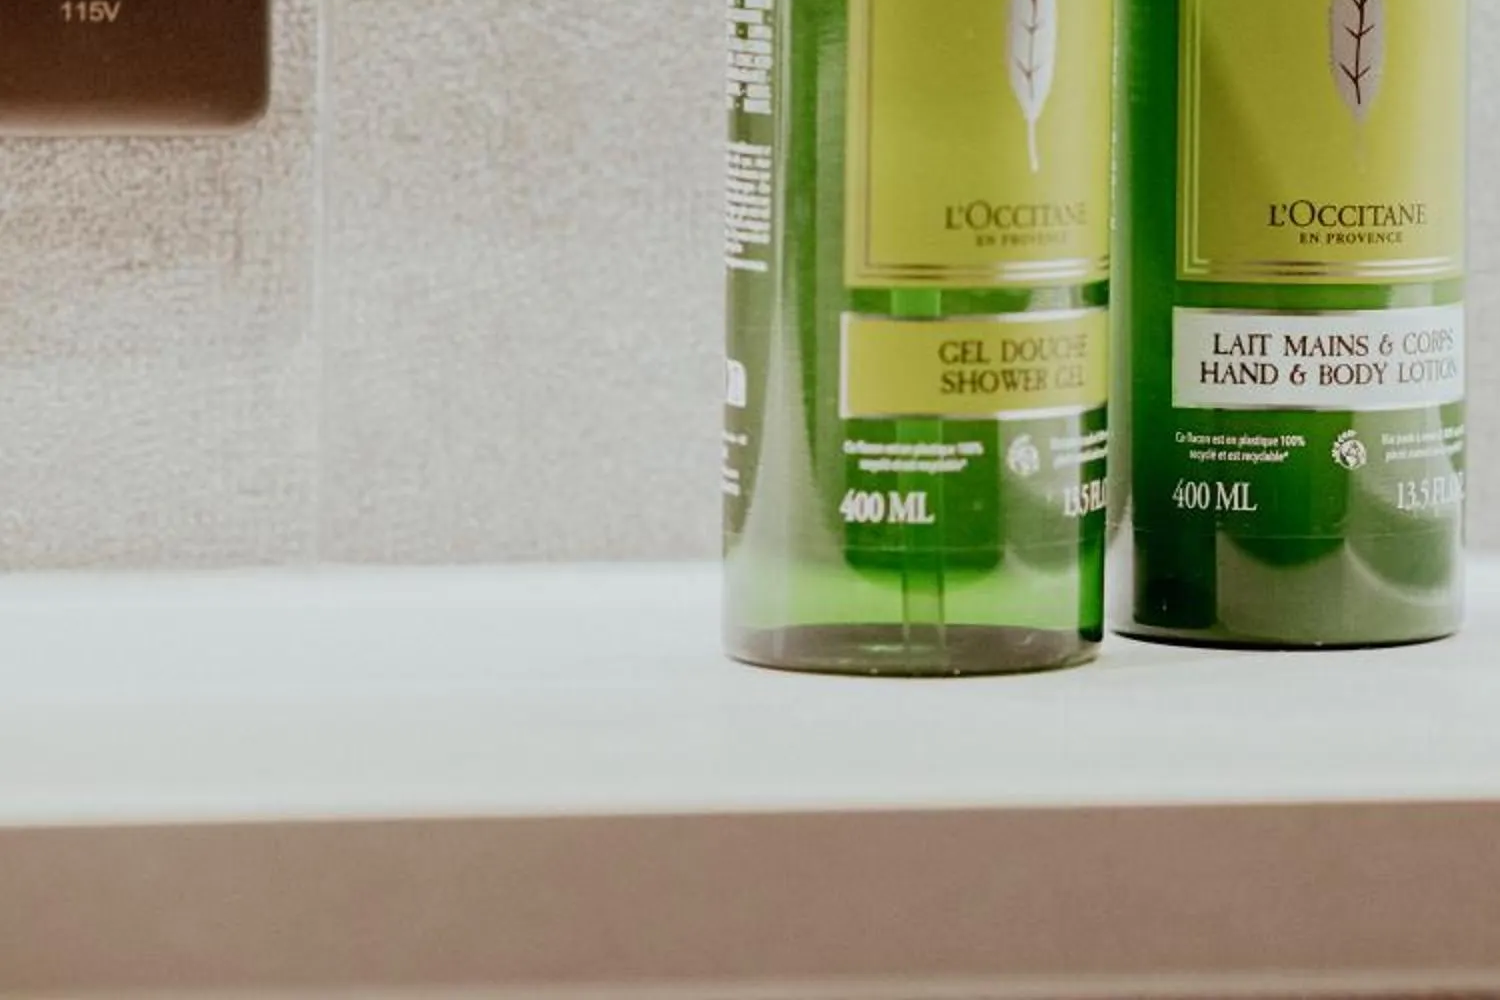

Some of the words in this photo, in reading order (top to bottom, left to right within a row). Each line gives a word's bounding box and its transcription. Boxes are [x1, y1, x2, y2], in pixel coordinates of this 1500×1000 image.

[61, 0, 121, 23] 115V
[1299, 232, 1319, 244] EN
[1326, 231, 1403, 244] PROVENCE
[938, 339, 991, 365] GEL
[1001, 334, 1089, 363] DOUCHE
[1213, 333, 1273, 357] LAIT
[1283, 334, 1369, 357] MAINS
[1379, 334, 1394, 354] &
[940, 369, 1049, 395] SHOWER
[1200, 361, 1279, 386] HAND
[1289, 363, 1307, 386] &
[1319, 362, 1387, 386] BODY
[839, 487, 885, 523] 400
[886, 490, 936, 524] ML
[1172, 478, 1211, 511] 400
[1214, 481, 1258, 512] ML
